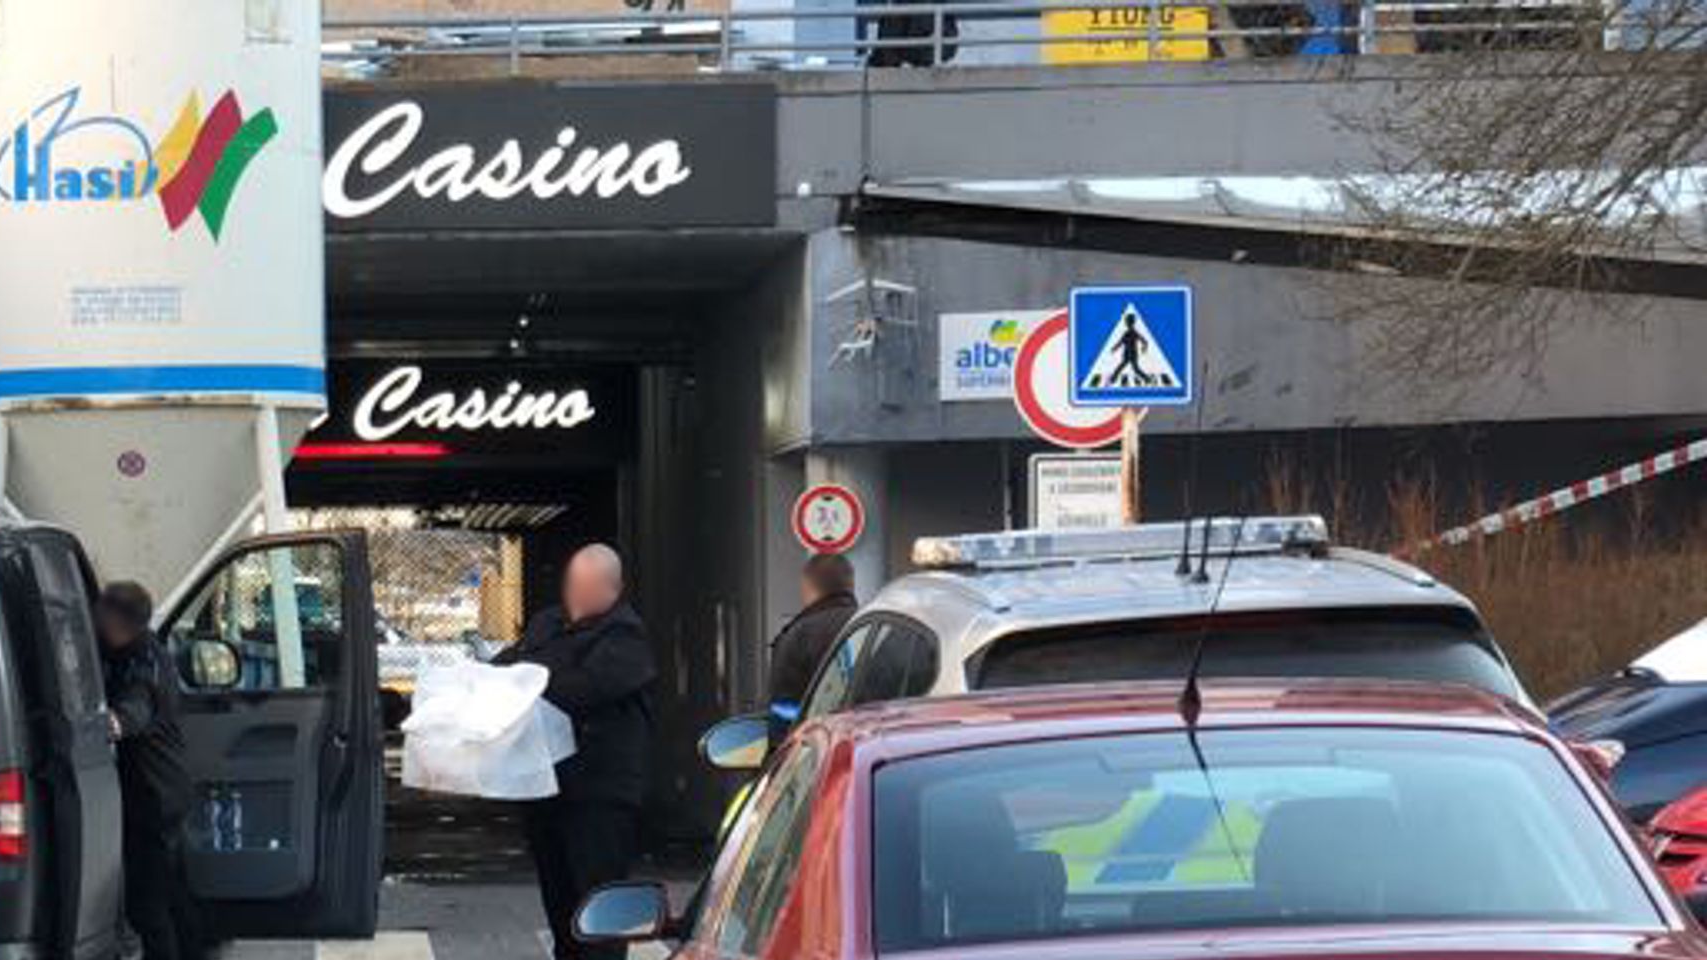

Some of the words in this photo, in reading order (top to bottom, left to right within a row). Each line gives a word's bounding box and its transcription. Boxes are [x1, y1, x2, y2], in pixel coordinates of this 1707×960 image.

[322, 100, 691, 218] Casino
[956, 341, 1017, 368] albe
[353, 365, 595, 442] Casino
